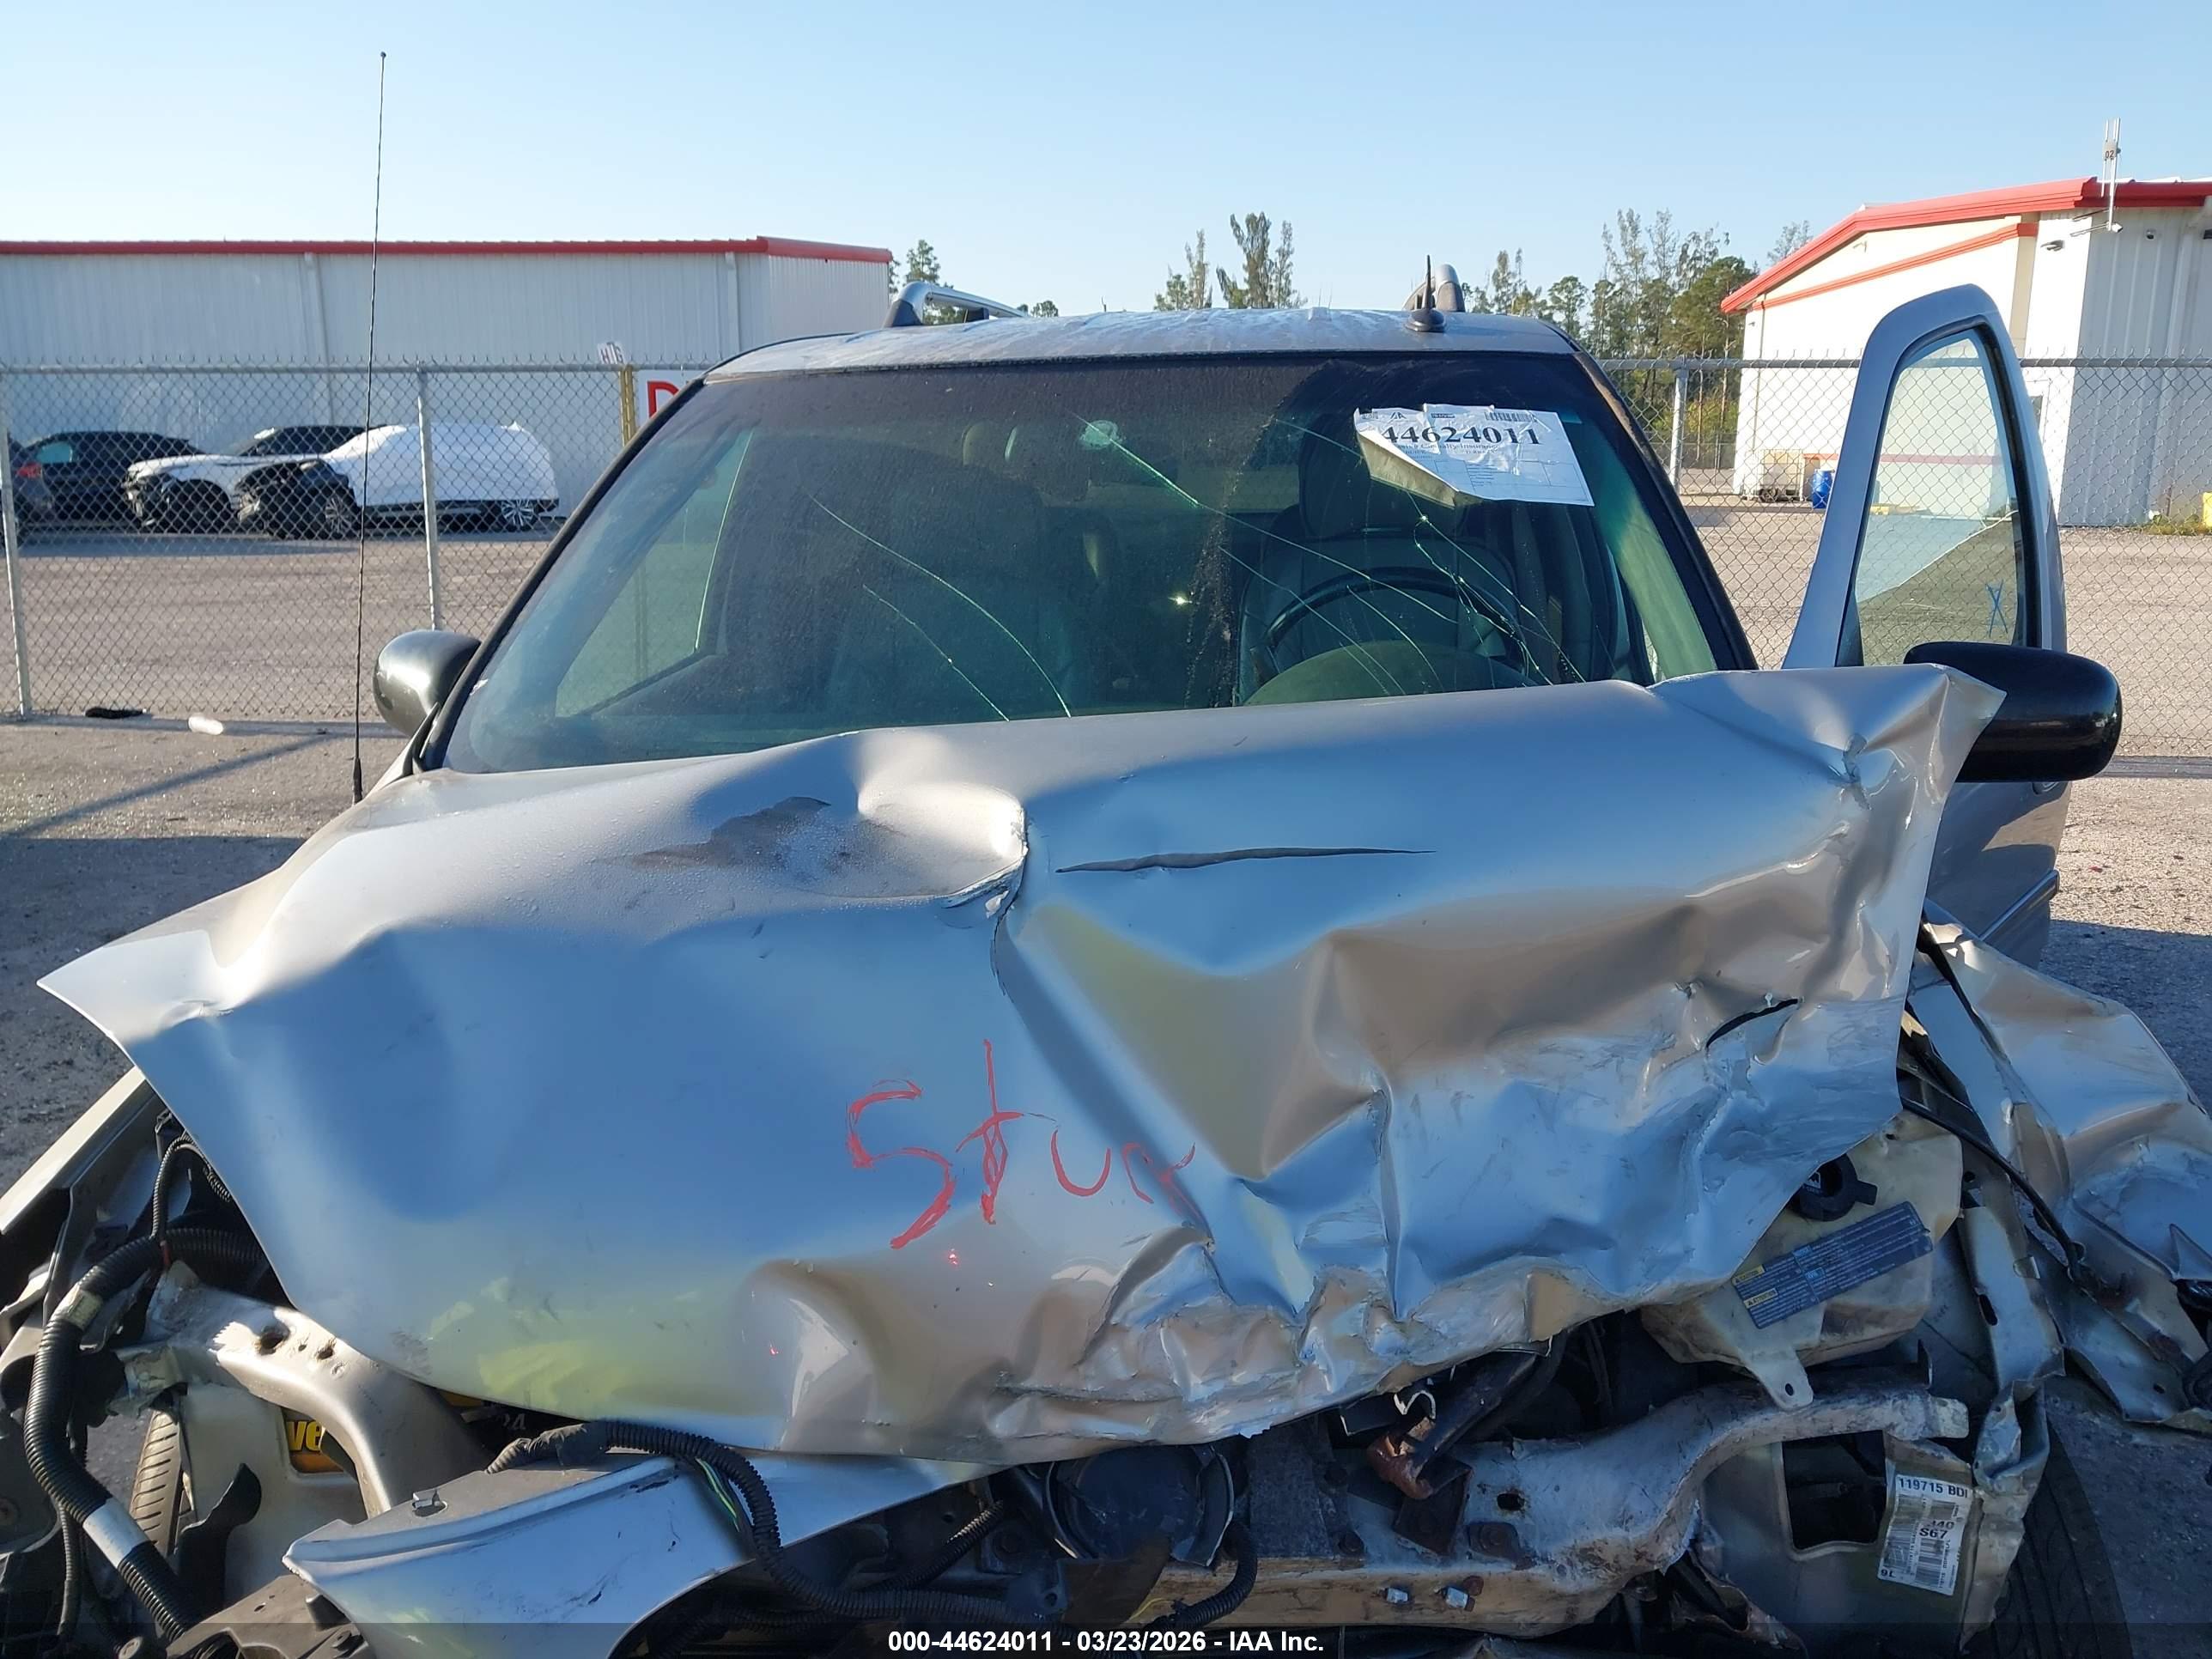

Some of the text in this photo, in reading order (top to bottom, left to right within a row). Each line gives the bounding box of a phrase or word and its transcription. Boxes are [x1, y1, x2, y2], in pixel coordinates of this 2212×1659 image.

[1381, 425, 1540, 445] 44624011
[1899, 1478, 1943, 1494] 119715
[1918, 1528, 1948, 1539] S67
